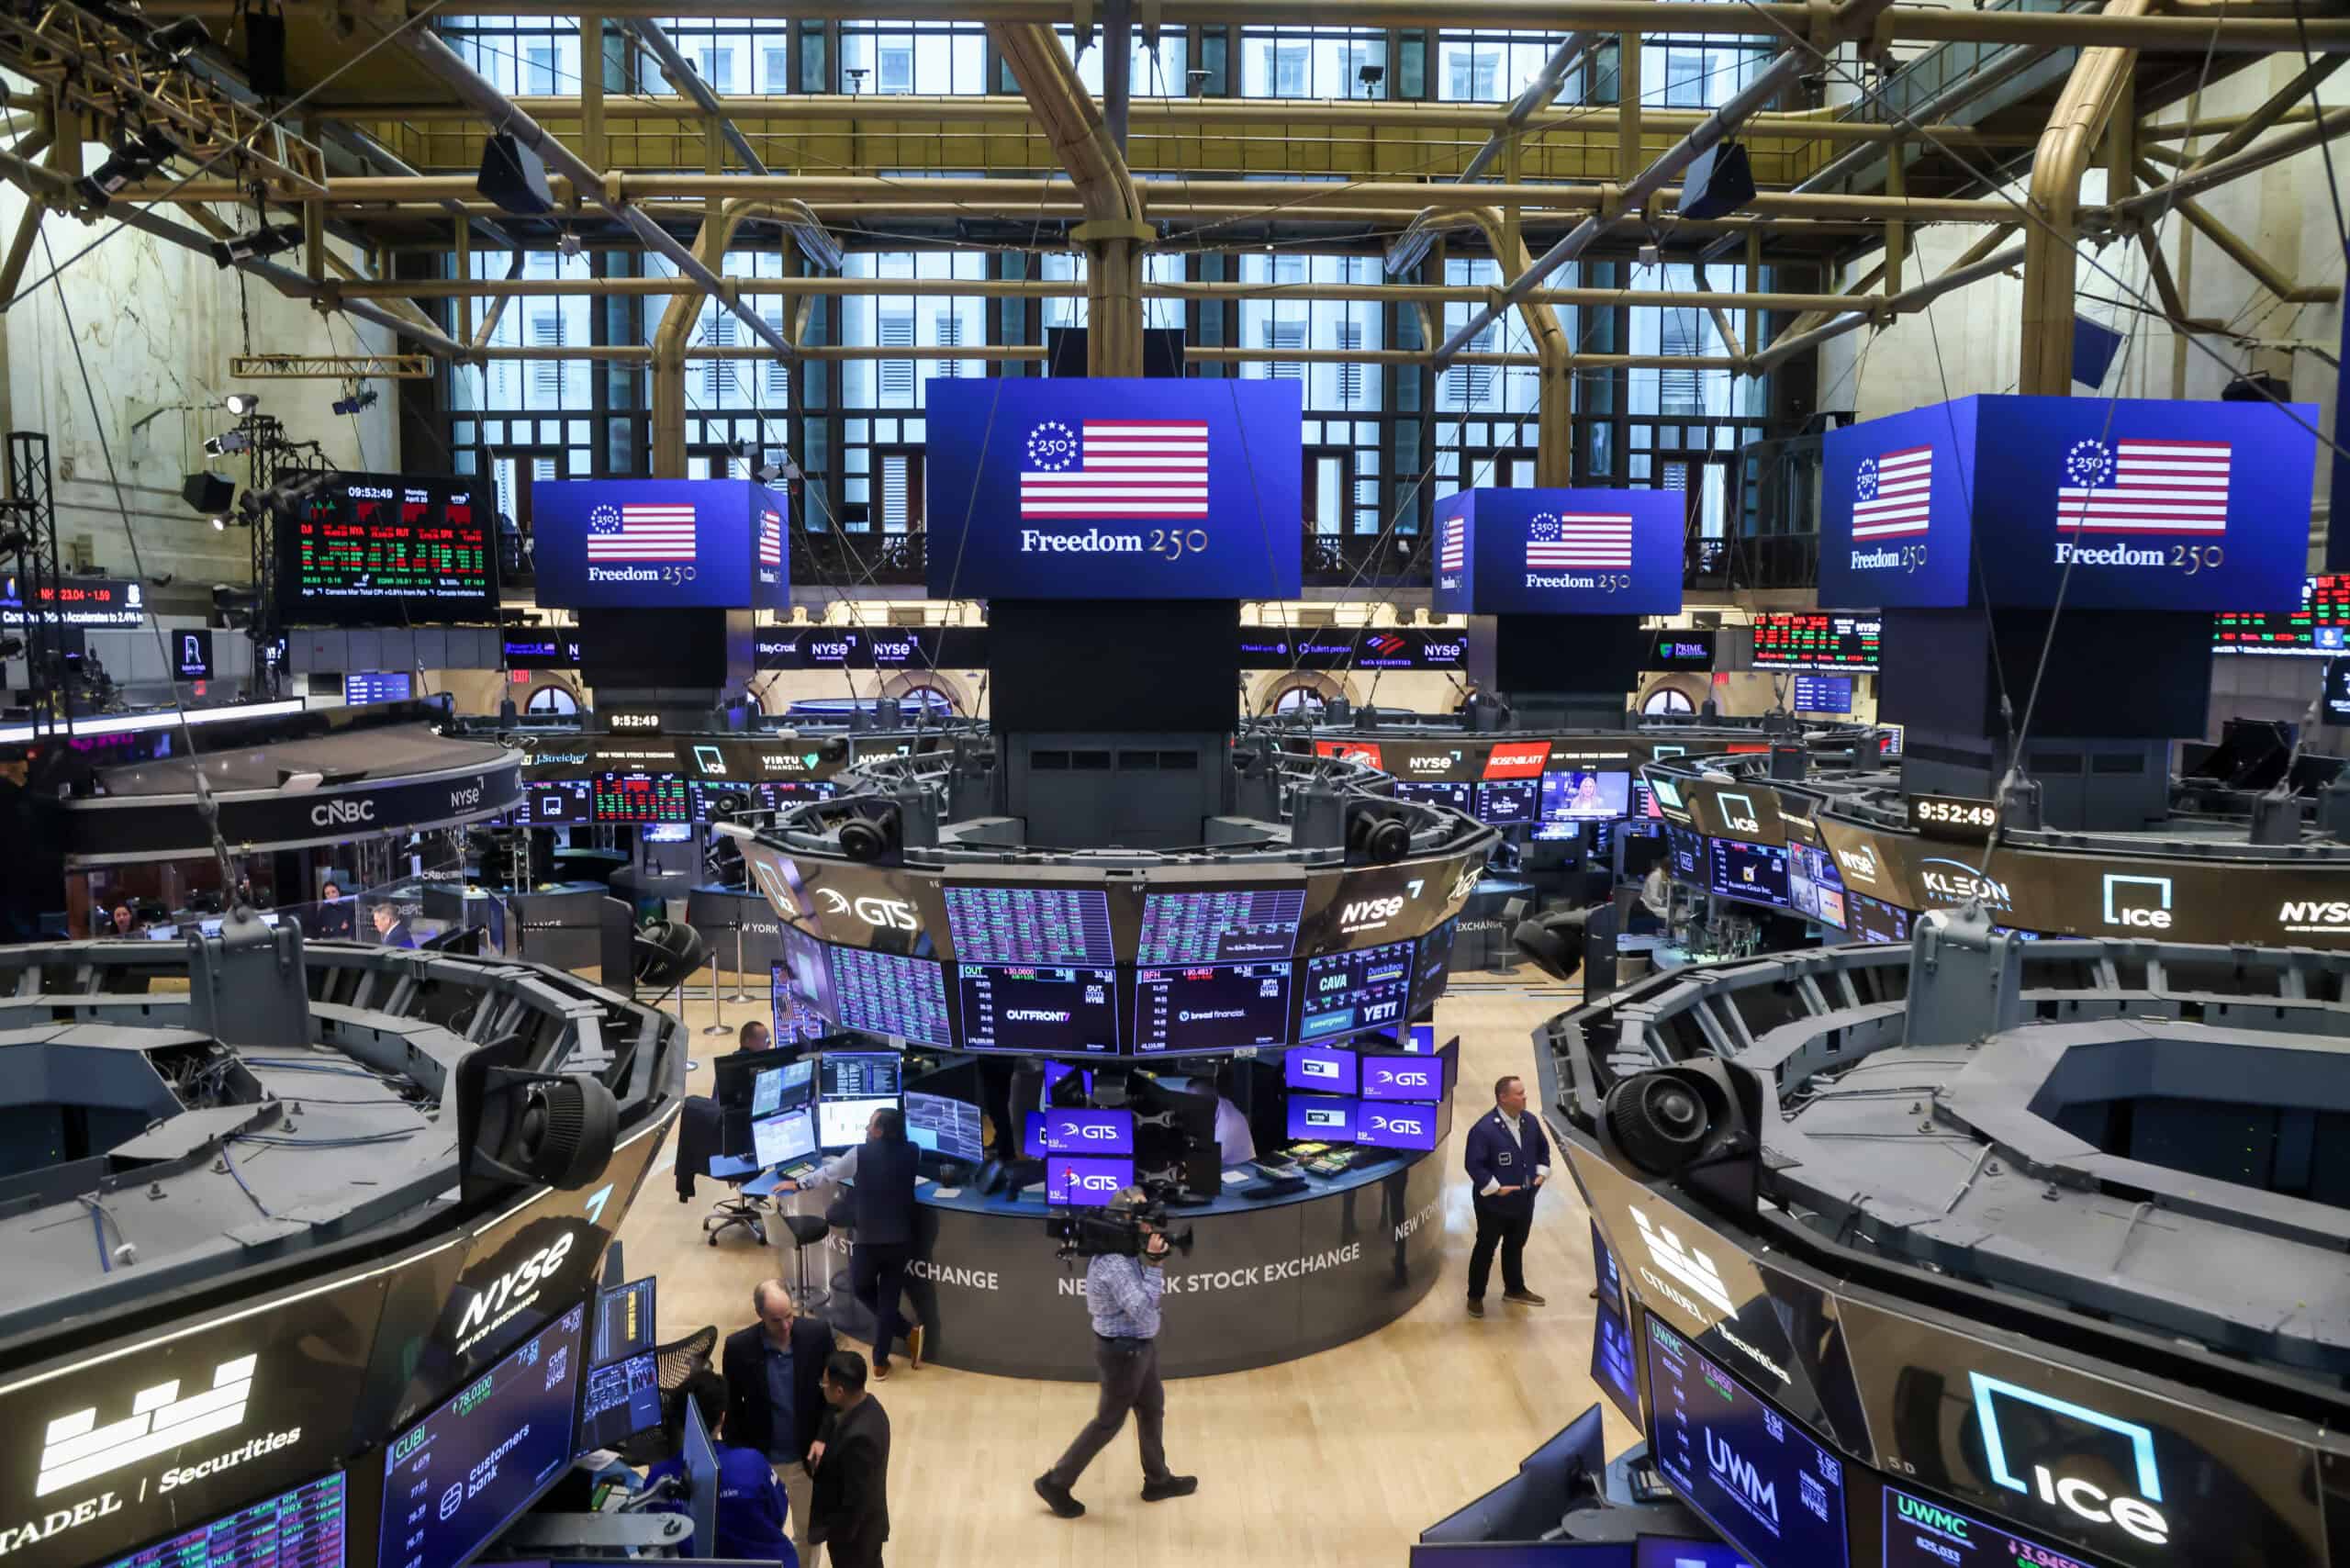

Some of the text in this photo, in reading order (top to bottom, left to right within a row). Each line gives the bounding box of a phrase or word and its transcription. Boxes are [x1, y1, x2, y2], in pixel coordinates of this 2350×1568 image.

[1037, 440, 1068, 455] 250
[2076, 454, 2104, 473] 250
[597, 514, 614, 526] 250
[1536, 521, 1553, 533] 250
[1021, 529, 1208, 561] Freedom 250
[1851, 544, 1928, 574] Freedom 250
[2054, 543, 2224, 576] Freedom 250
[588, 566, 697, 587] Freedom 250
[1526, 574, 1631, 594] Freedom 250
[611, 715, 659, 726] 9:52:49
[762, 756, 800, 764] VIRTU
[765, 763, 804, 771] FINANCIAL
[1490, 754, 1544, 766] ROSENBLATT
[310, 800, 375, 826] CNBC
[1919, 802, 1996, 826] 9:52:49
[855, 897, 918, 931] GTS
[751, 921, 778, 934] YORK
[965, 966, 983, 975] OUT
[1319, 974, 1348, 991] CAVA
[1363, 1001, 1398, 1022] YETI
[1395, 1072, 1427, 1086] GTS
[1082, 1125, 1117, 1139] GTS
[1390, 1119, 1422, 1135] GTS
[1083, 1174, 1118, 1191] GTS
[903, 1259, 999, 1291] XCHANGE
[1187, 1266, 1259, 1293] STOCK
[1263, 1242, 1360, 1283] EXCHANGE
[1058, 1277, 1087, 1295] NE
[396, 1424, 426, 1459] CUBI
[159, 1425, 301, 1495] Securities
[468, 1424, 530, 1481] customers
[467, 1464, 498, 1499] bank
[1705, 1427, 1779, 1523] UWM
[1897, 1495, 1968, 1538] UWMC
